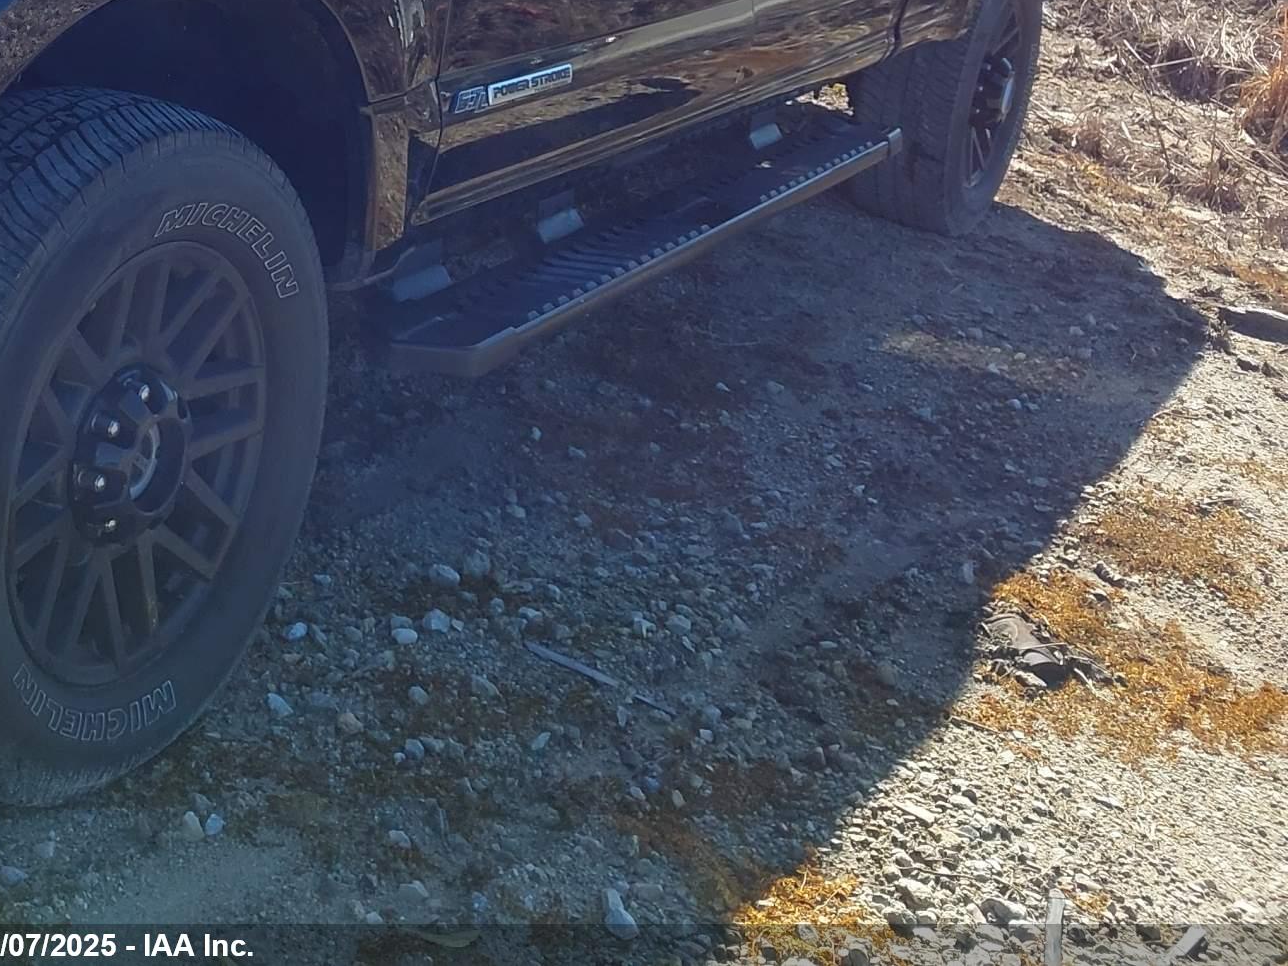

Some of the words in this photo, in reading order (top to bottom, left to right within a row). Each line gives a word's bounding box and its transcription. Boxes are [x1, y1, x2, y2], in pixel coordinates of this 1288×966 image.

[492, 78, 530, 98] POWER
[154, 202, 300, 298] MICHELIN
[13, 663, 177, 741] MICHELIN
